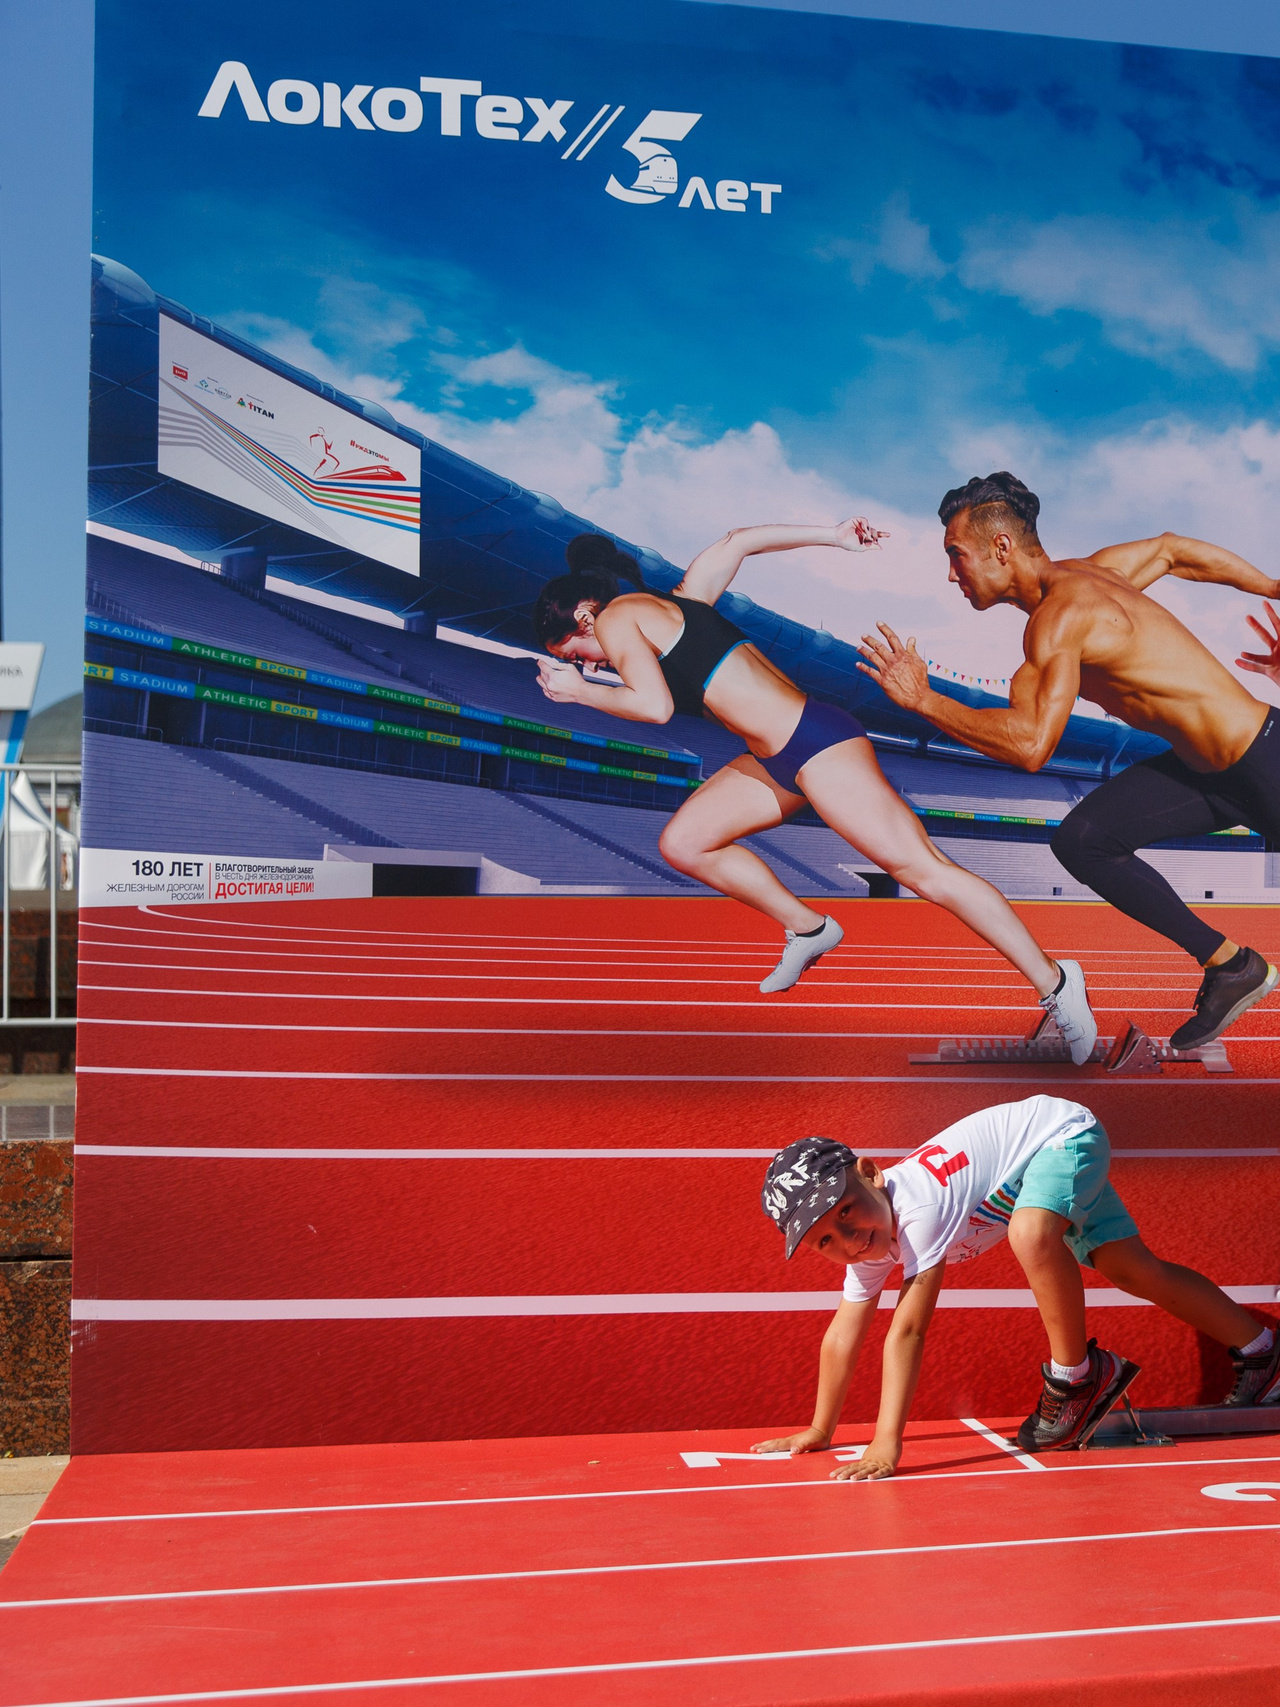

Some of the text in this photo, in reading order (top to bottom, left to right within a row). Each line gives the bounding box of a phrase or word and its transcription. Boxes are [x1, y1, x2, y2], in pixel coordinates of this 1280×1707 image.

[605, 110, 702, 204] 5
[89, 620, 164, 646] STADIUM
[180, 643, 251, 666] ATHLETIC
[260, 661, 304, 678] SPORT
[311, 674, 362, 691] STADIUM
[373, 688, 421, 705] ATHLETIC
[427, 700, 458, 713] SPORT
[463, 708, 500, 722] STADIUM
[507, 719, 544, 733] ATHLETIC
[120, 673, 188, 693] STADIUM
[203, 690, 267, 709] ATHLETIC
[275, 703, 314, 718] SPORT
[322, 713, 369, 728] STADIUM
[379, 724, 425, 739] ATHLETIC
[429, 733, 458, 745] SPORT
[463, 740, 498, 753] STADIUM
[505, 748, 539, 760] ATHLETIC
[602, 766, 632, 777] ATHLETIC
[132, 860, 203, 876] 180 ЛЕТ
[215, 863, 296, 873] БЛАГОТВОРИТЕЛЬНЫЙ
[244, 873, 257, 881] ДНЯ
[106, 884, 204, 892] ЖЕЛЕЗНЫМ ДОРОГАМ
[215, 882, 315, 899] ДОСТИГАЯ ЦЕЛИ!
